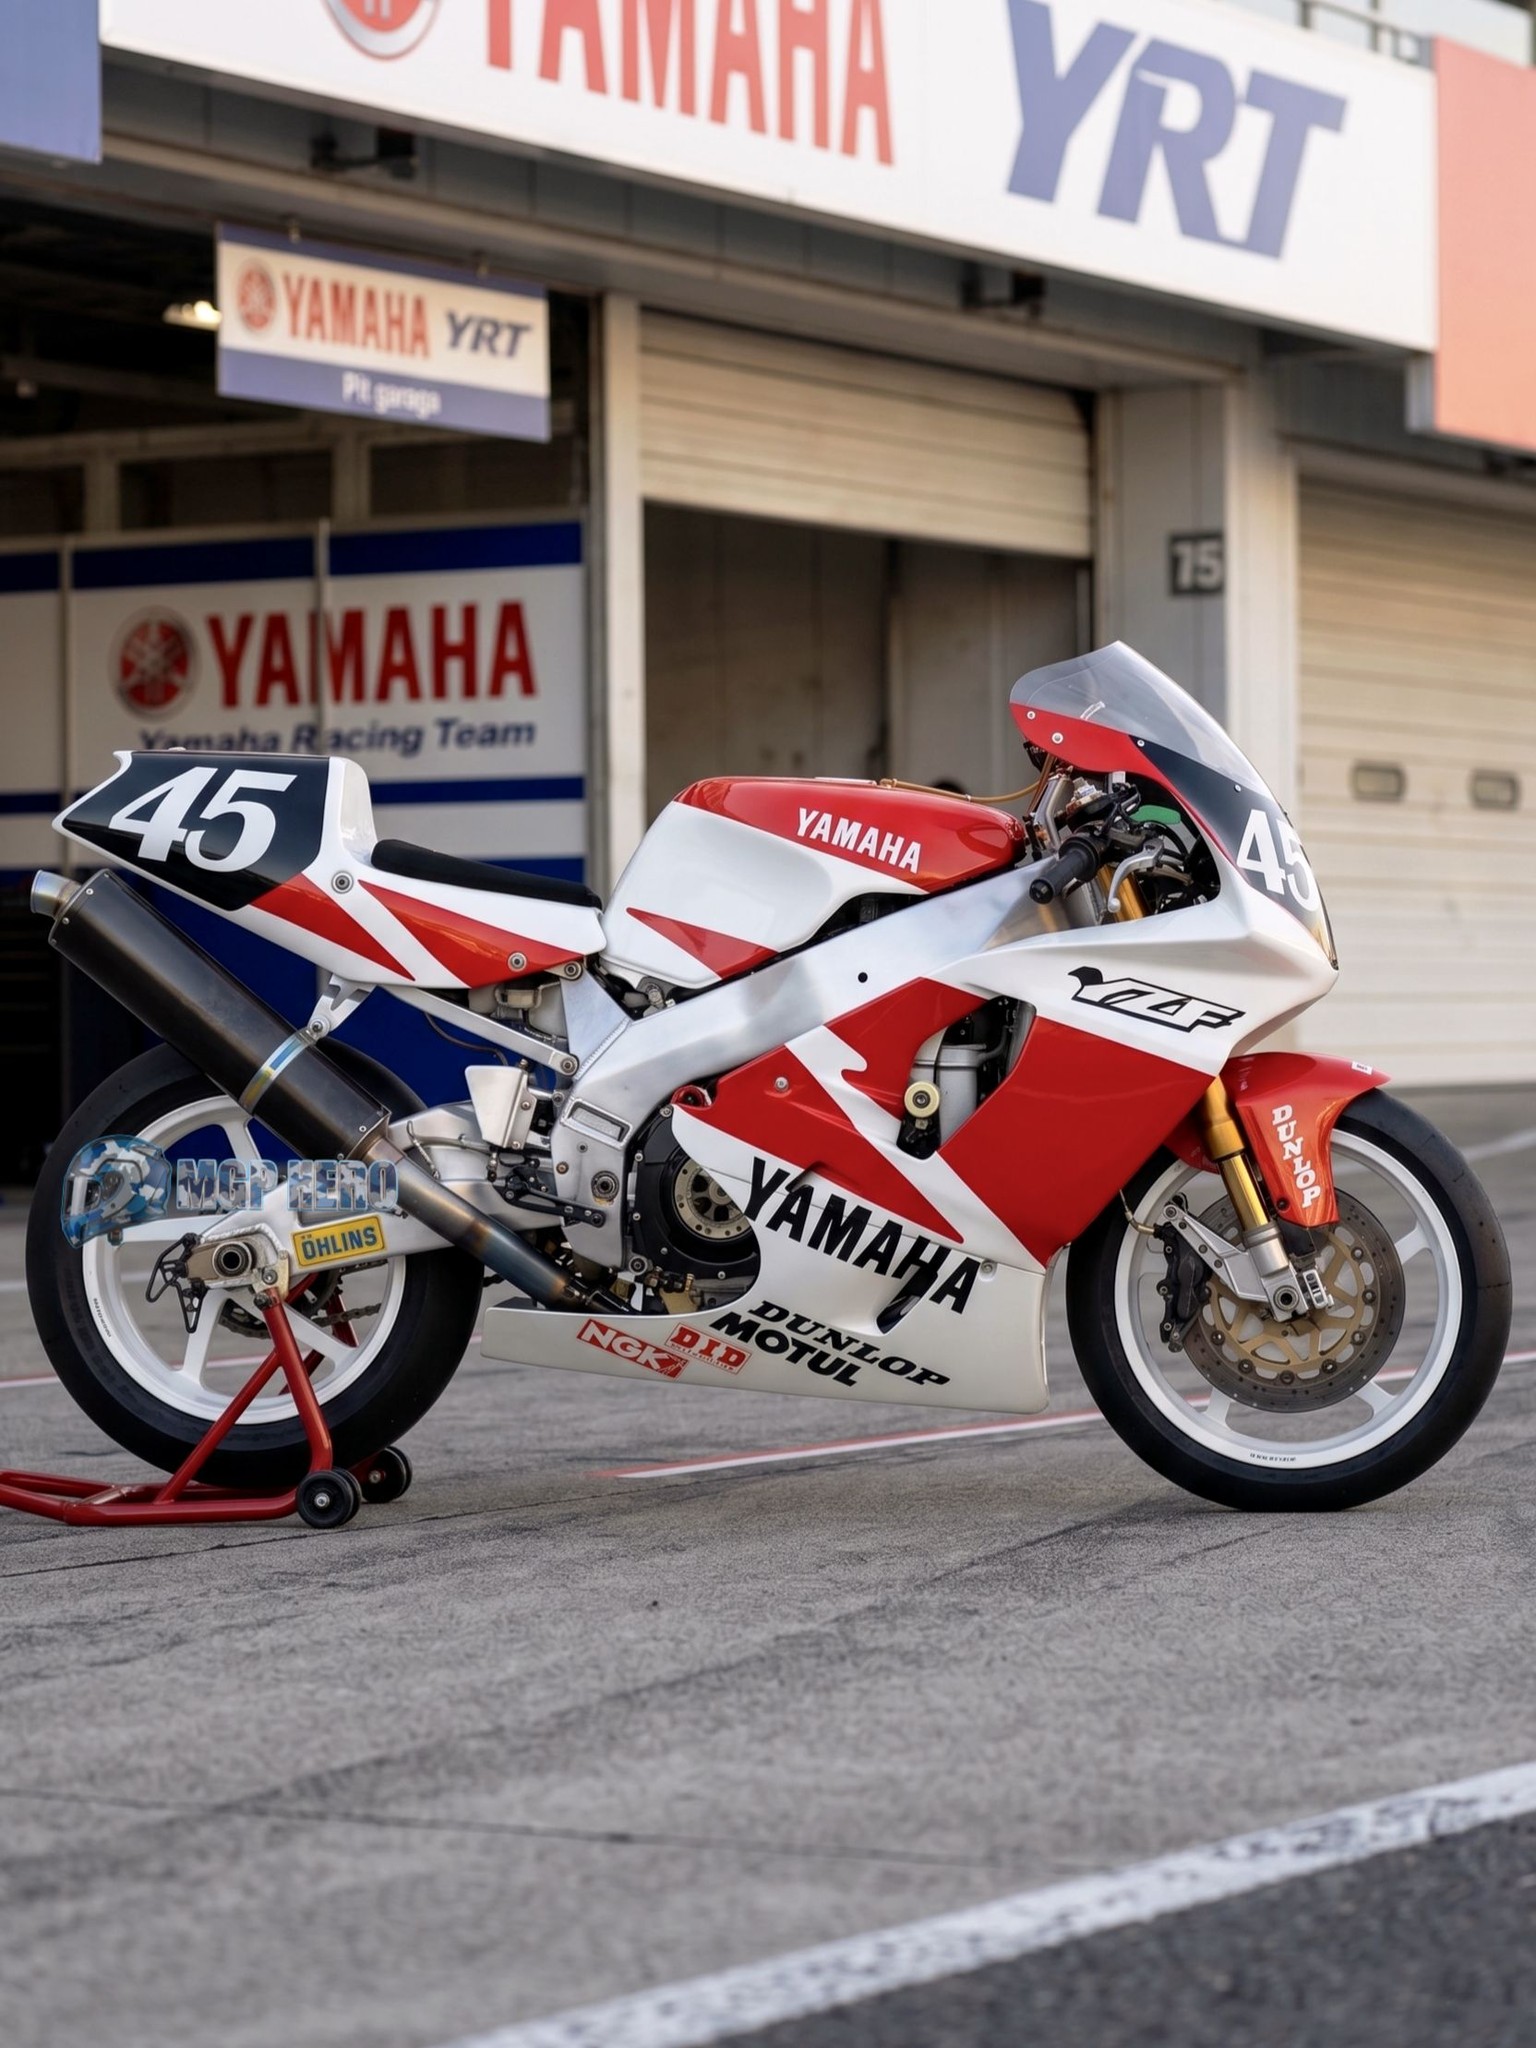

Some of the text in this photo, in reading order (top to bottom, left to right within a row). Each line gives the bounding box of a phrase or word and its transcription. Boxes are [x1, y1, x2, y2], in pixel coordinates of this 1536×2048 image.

[487, 0, 1349, 260] AHA YRT
[283, 271, 533, 360] YAMAHA YRT
[1176, 540, 1223, 589] 15
[207, 601, 537, 709] YAMAHA
[138, 715, 536, 757] Yamaha Racing Team
[108, 767, 298, 873] 45
[797, 807, 922, 874] YAMAHA
[1236, 808, 1321, 912] 45
[1067, 966, 1247, 1032] YZF
[1271, 1104, 1322, 1209] DUNLOP
[301, 1226, 379, 1261] ÖHLINS
[743, 1156, 982, 1315] YAMAHA
[580, 1321, 670, 1370] NGK
[669, 1326, 747, 1368] DID
[708, 1312, 865, 1388] MOTUL
[748, 1300, 951, 1387] DUNLOP
